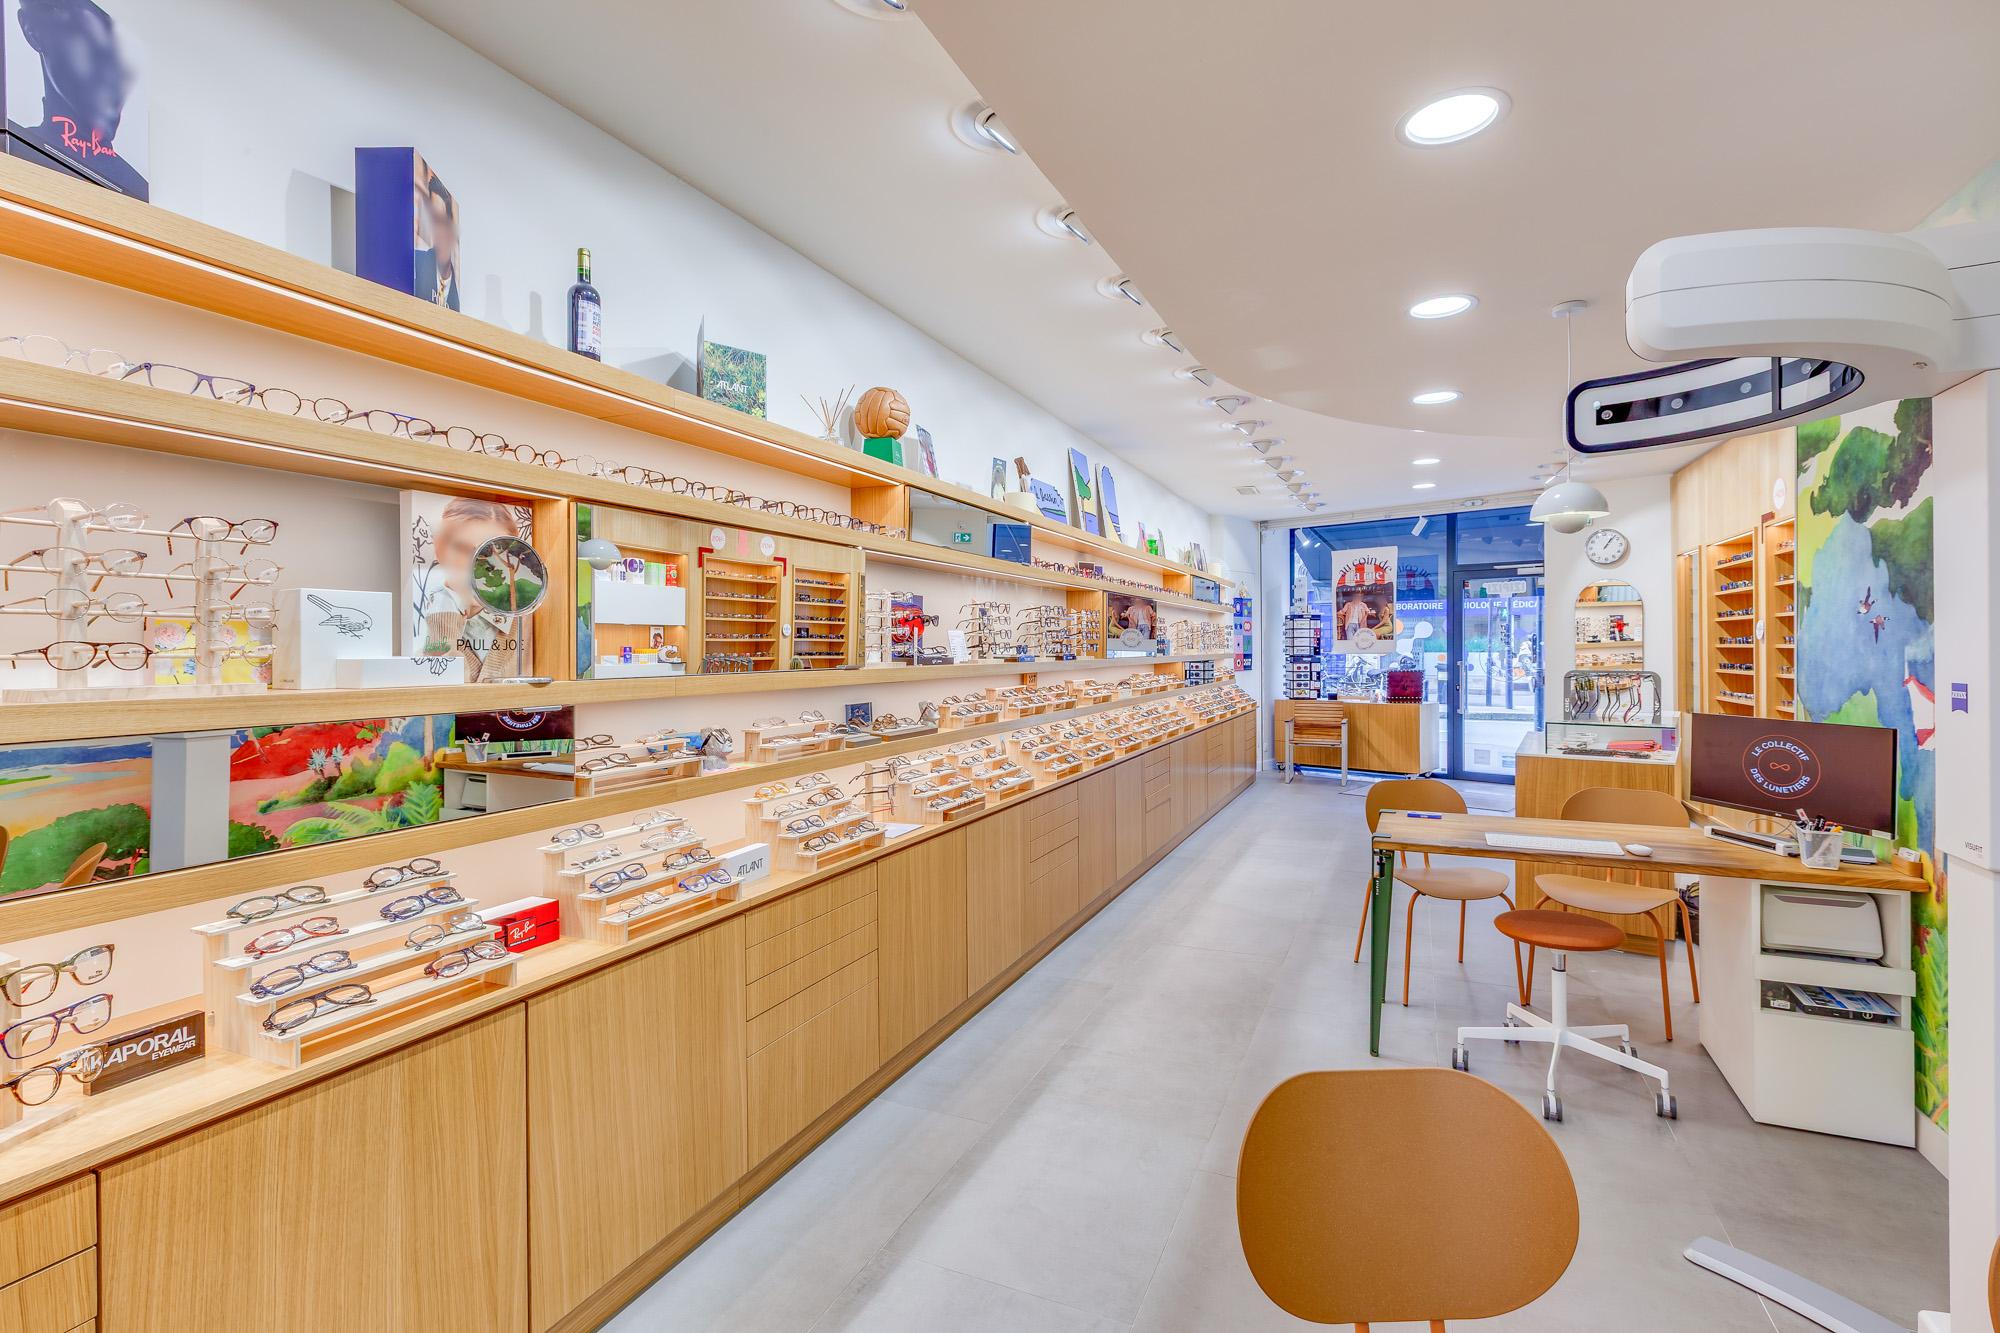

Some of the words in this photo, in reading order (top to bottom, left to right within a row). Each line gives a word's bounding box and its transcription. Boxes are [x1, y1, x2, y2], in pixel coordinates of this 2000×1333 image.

[51, 115, 117, 158] Ray-Ban
[716, 380, 749, 393] ATLANT
[1339, 563, 1352, 576] au
[1352, 555, 1377, 567] coin
[1379, 560, 1392, 574] de
[456, 639, 489, 651] PAUL
[491, 639, 501, 651] &
[1751, 746, 1763, 757] LE
[1761, 740, 1810, 761] COLLECTIF
[1750, 767, 1765, 783] DES
[1763, 775, 1811, 794] LUNETIERS
[736, 857, 764, 878] ATLANT
[89, 1027, 196, 1071] KAPORAL
[151, 1039, 196, 1061] EYEWEAR
